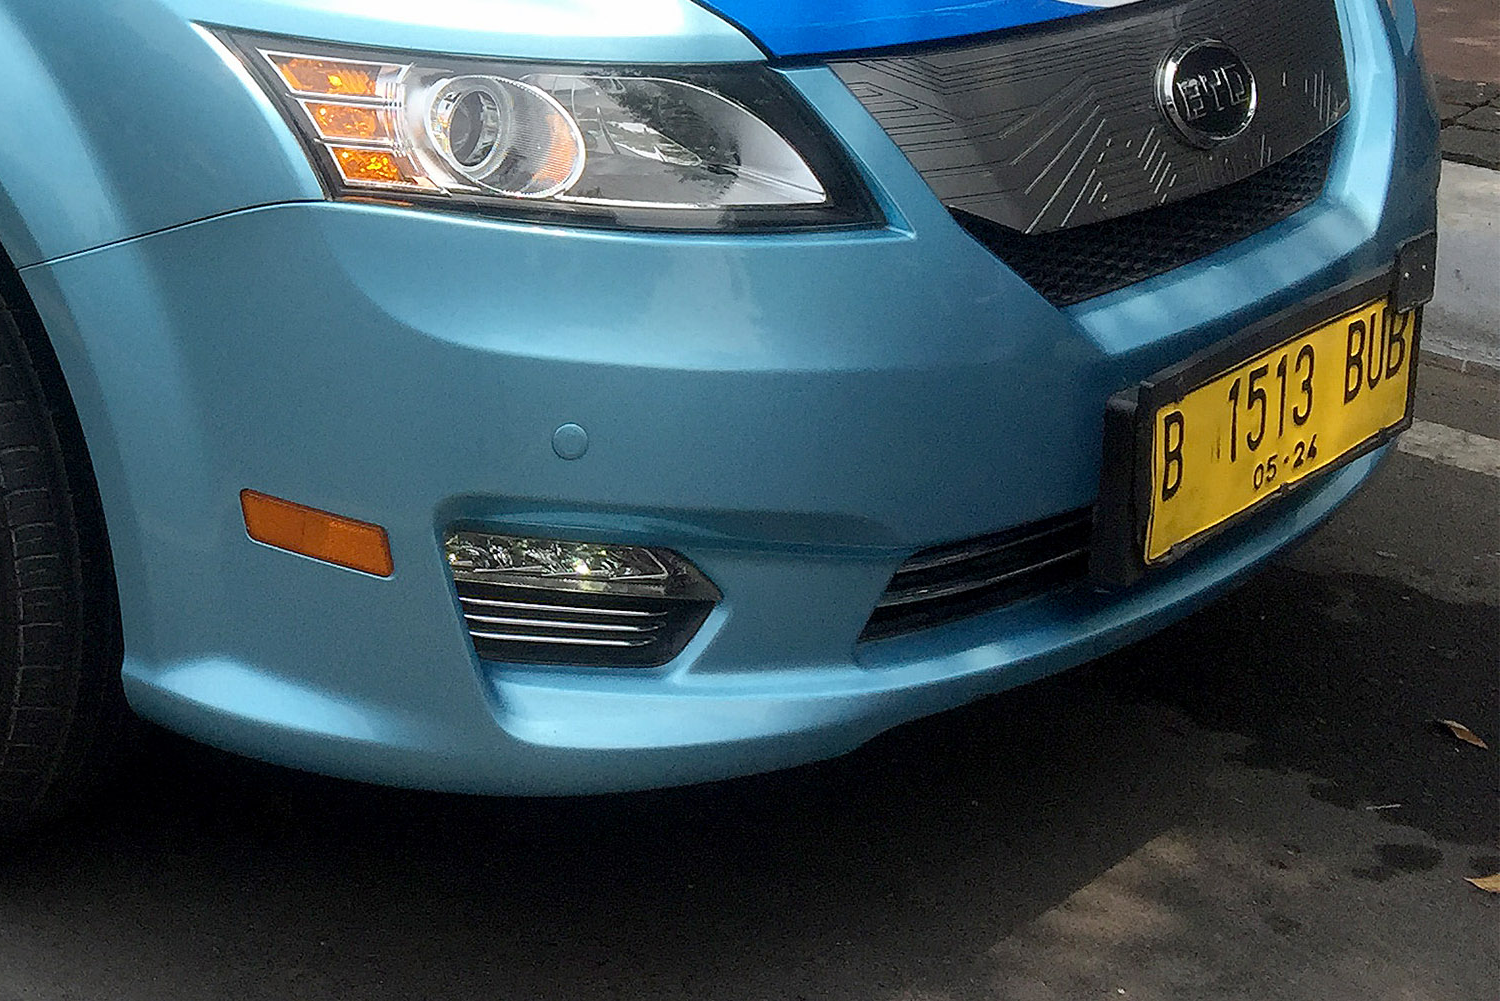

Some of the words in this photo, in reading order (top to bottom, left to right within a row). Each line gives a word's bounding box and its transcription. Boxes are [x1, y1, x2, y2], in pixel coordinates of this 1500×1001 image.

[1176, 64, 1249, 121] BYD
[1161, 411, 1184, 502] B
[1228, 343, 1315, 463] 1513
[1343, 306, 1406, 406] BUB
